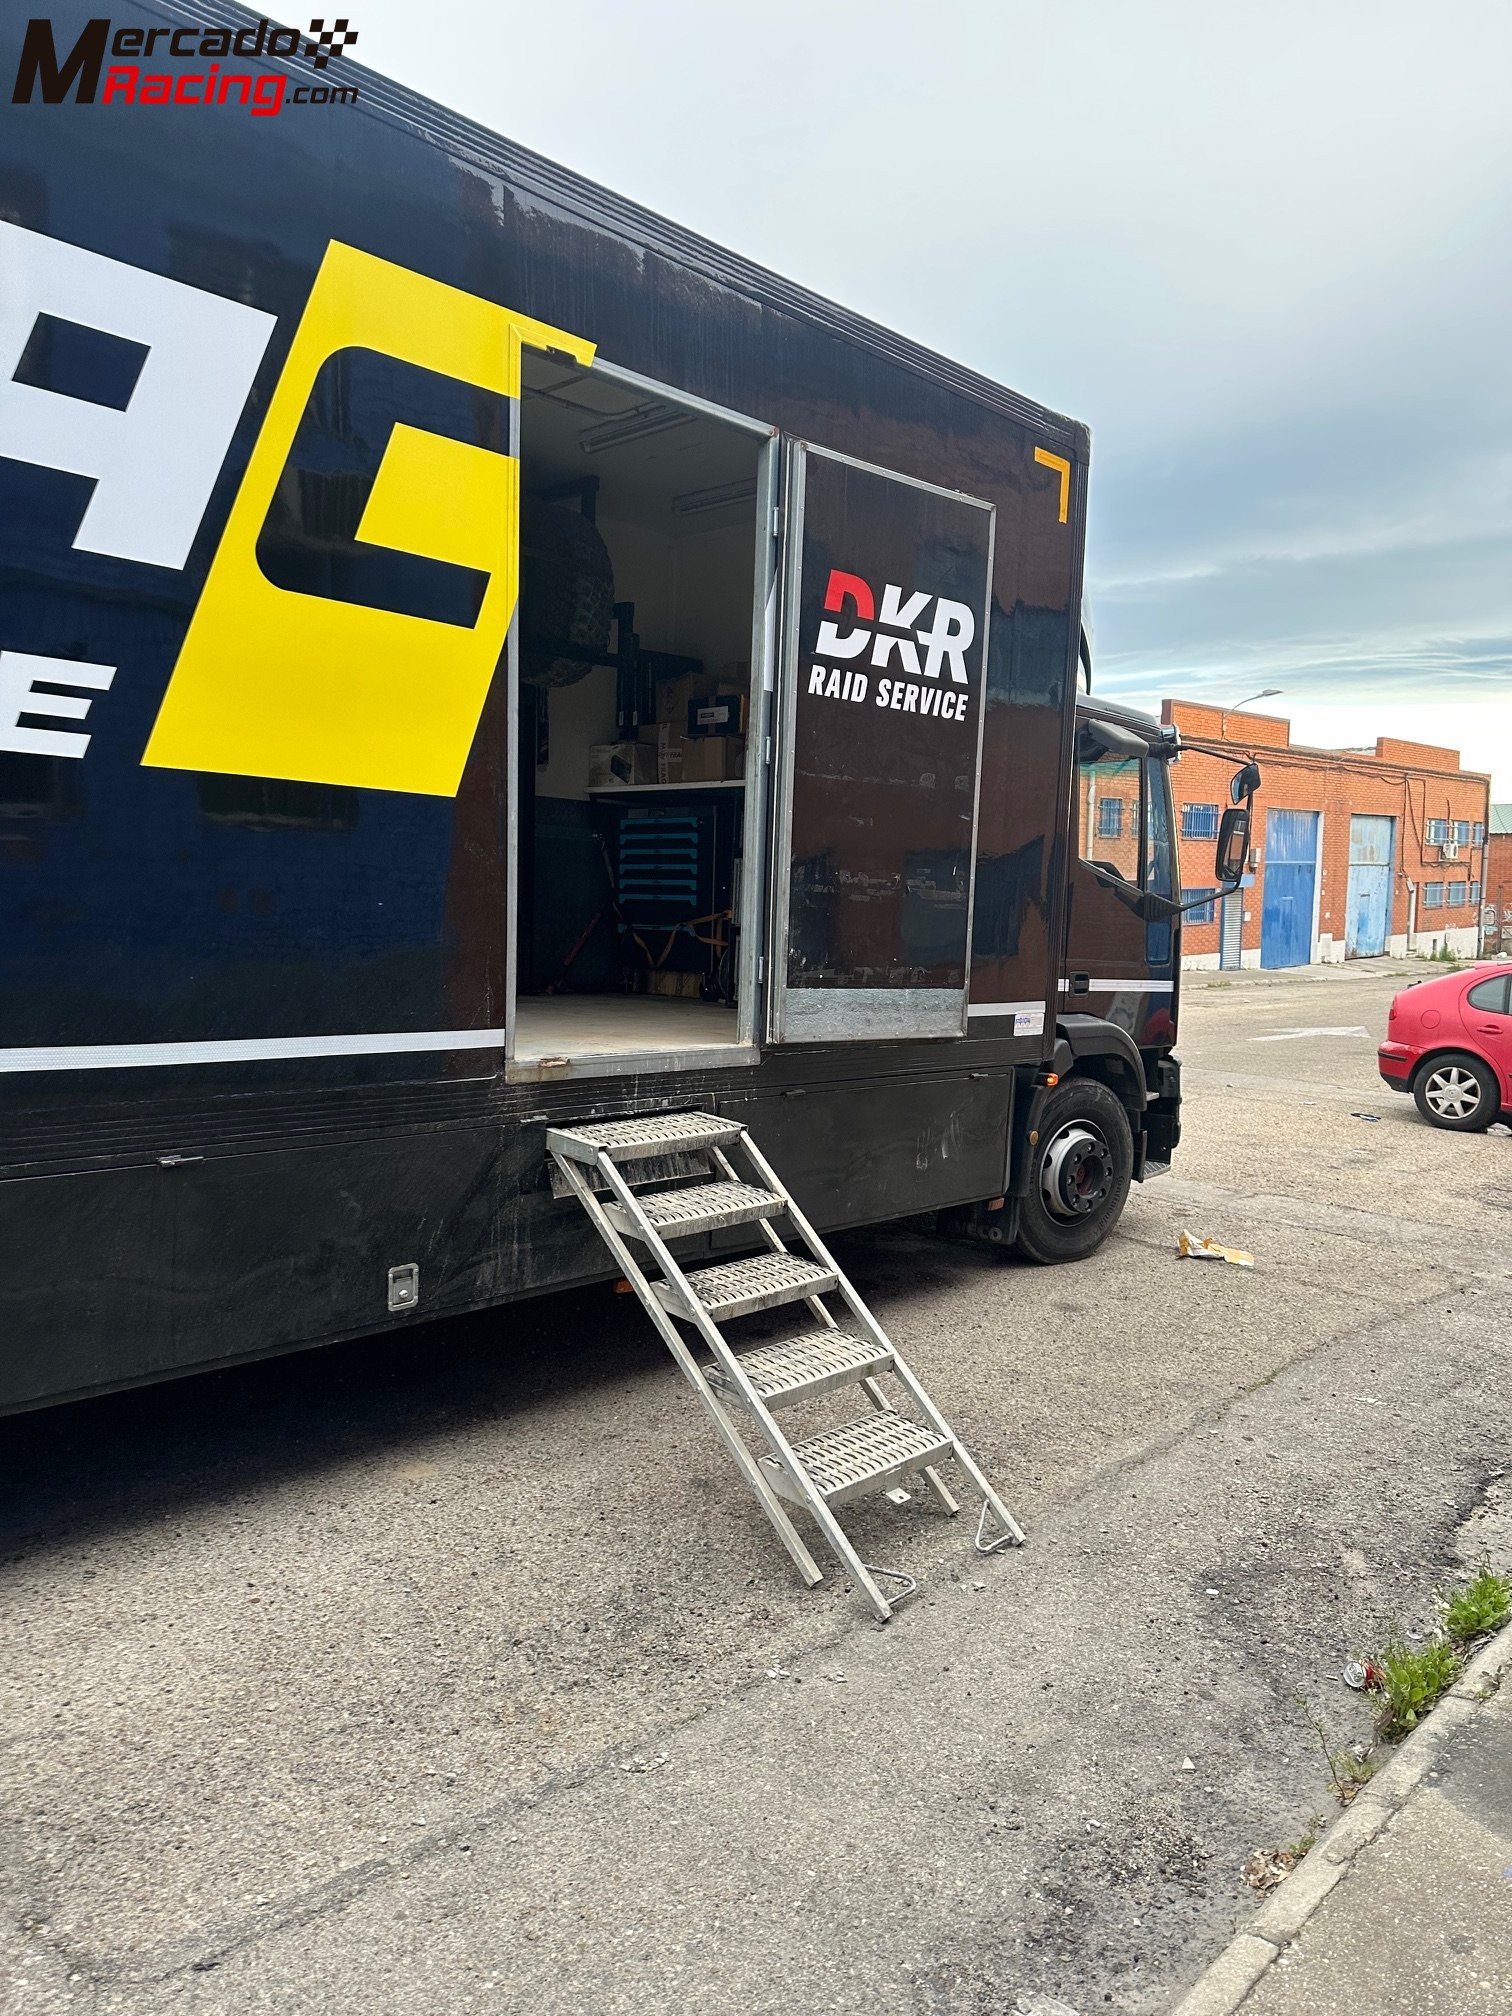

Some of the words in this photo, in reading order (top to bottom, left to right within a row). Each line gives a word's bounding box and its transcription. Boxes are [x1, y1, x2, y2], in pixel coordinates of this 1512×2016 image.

[815, 569, 975, 684] DKR
[807, 664, 869, 703] RAID
[875, 678, 969, 722] SERVICE
